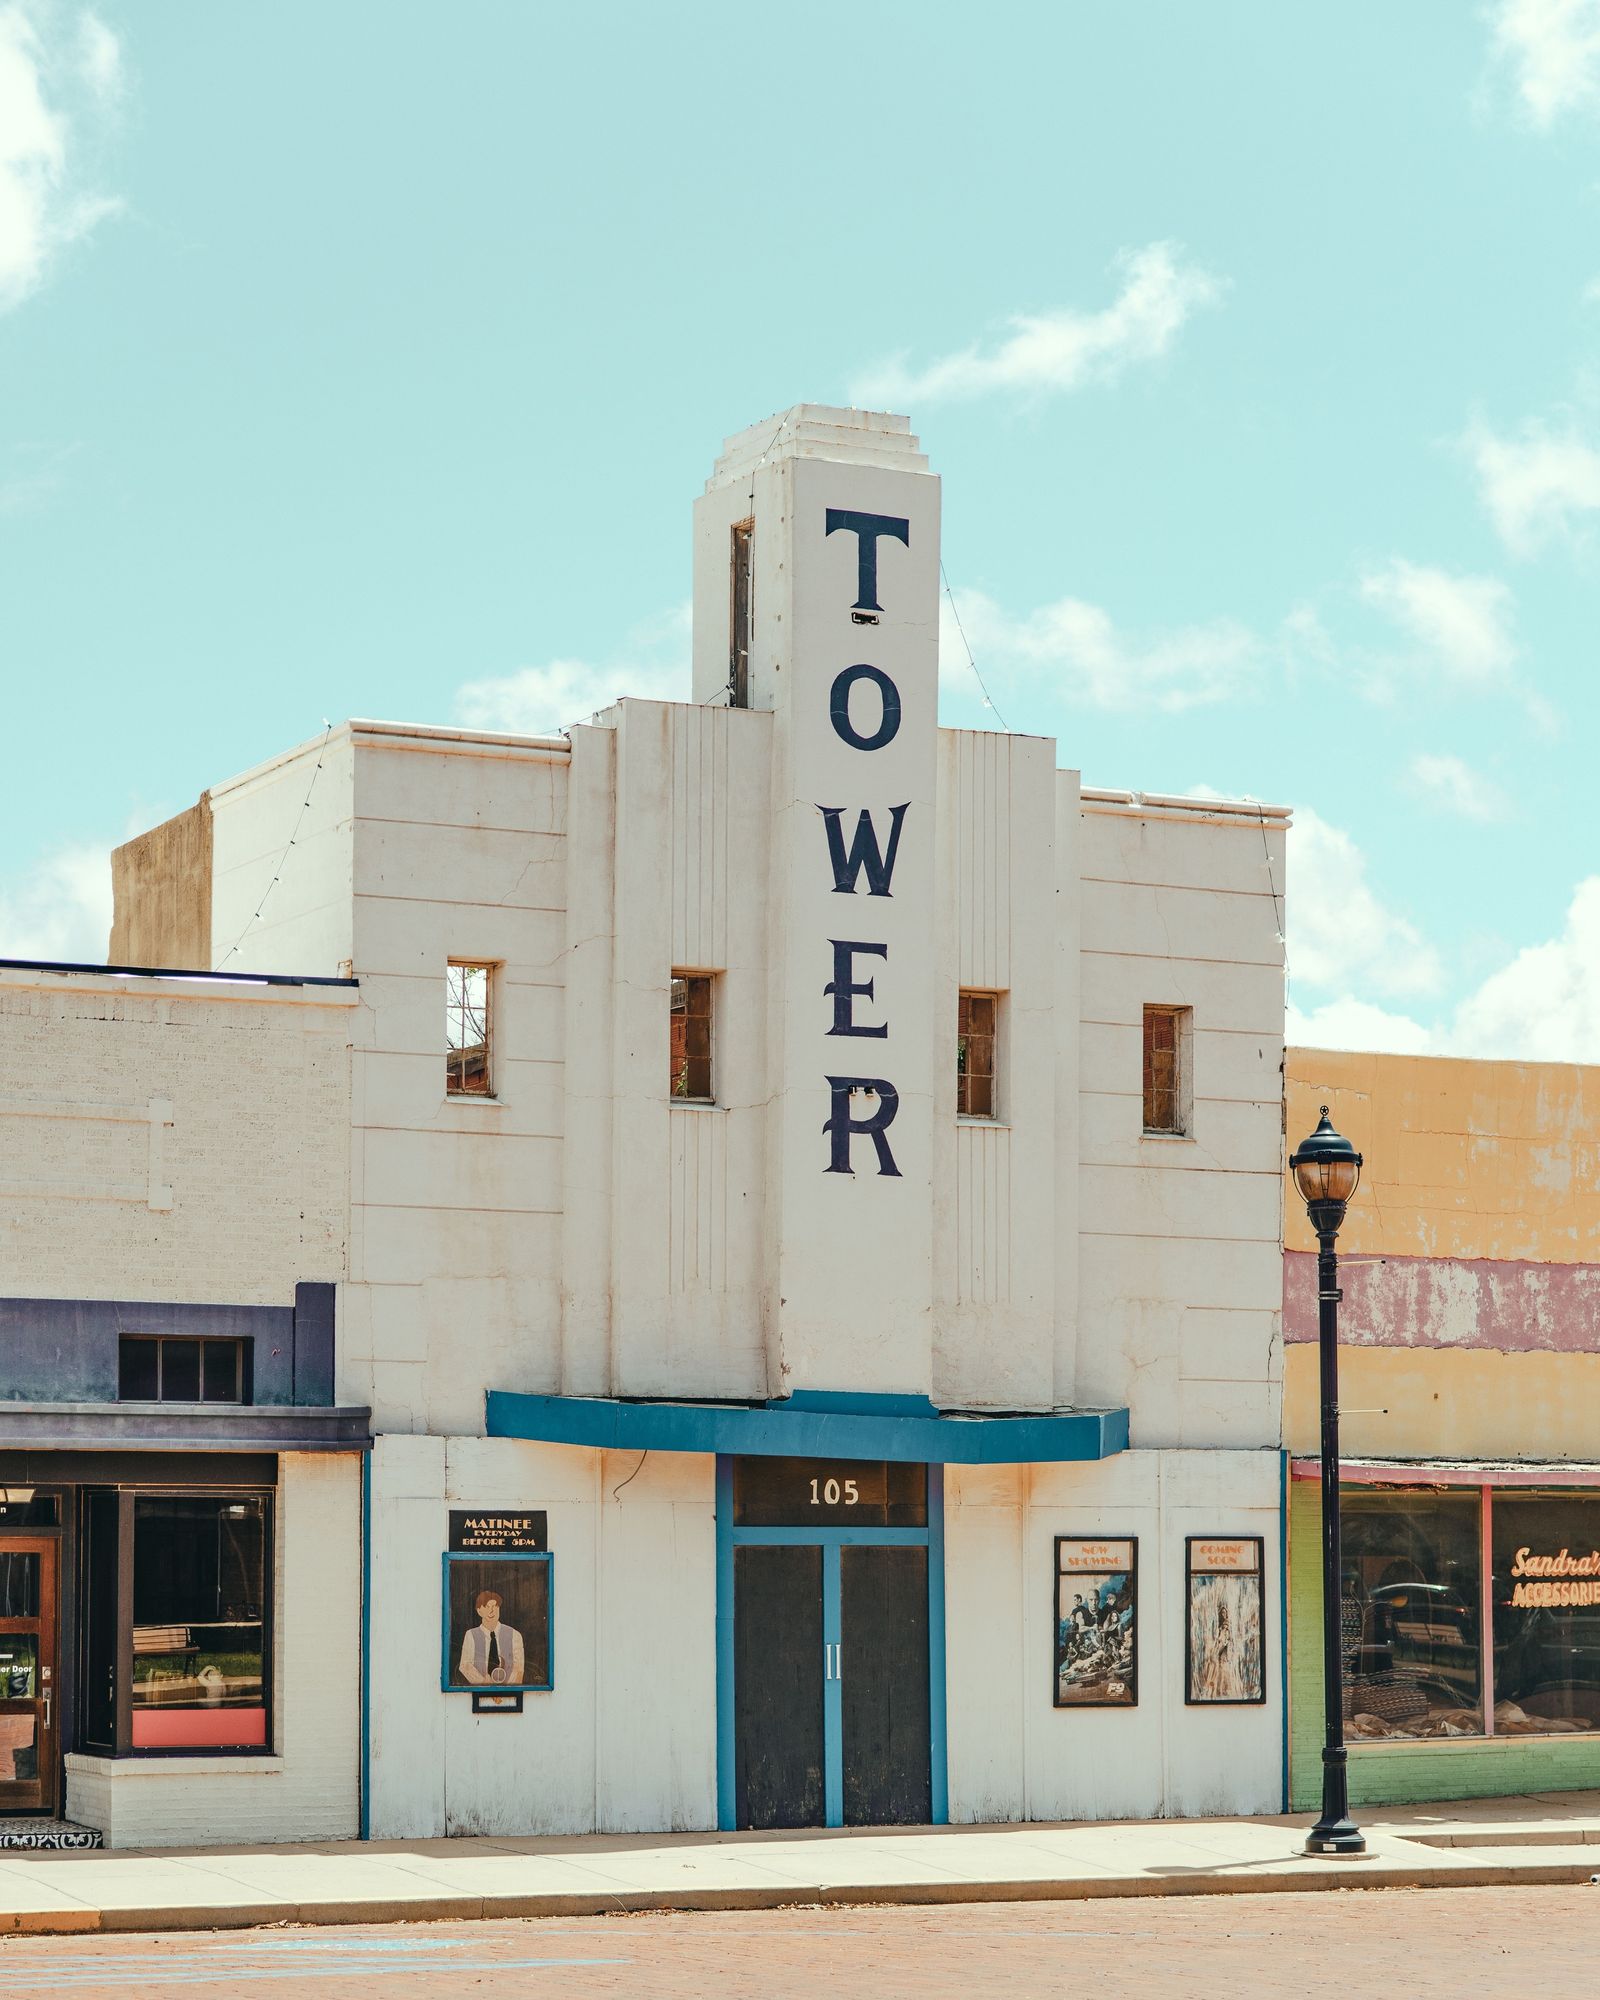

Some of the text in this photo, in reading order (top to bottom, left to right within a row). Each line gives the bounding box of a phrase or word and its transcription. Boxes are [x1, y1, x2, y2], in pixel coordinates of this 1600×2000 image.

[813, 506, 912, 1177] TOWER
[809, 1478, 859, 1505] 105
[464, 1518, 532, 1529] MATINEE
[462, 1538, 505, 1546] BEFORE
[1081, 1546, 1109, 1555] NOW
[1200, 1545, 1244, 1554] COMING
[1068, 1557, 1122, 1566] SHOWING
[1207, 1556, 1238, 1565] SOON
[12, 1665, 33, 1673] Door
[1107, 1682, 1125, 1693] F9
